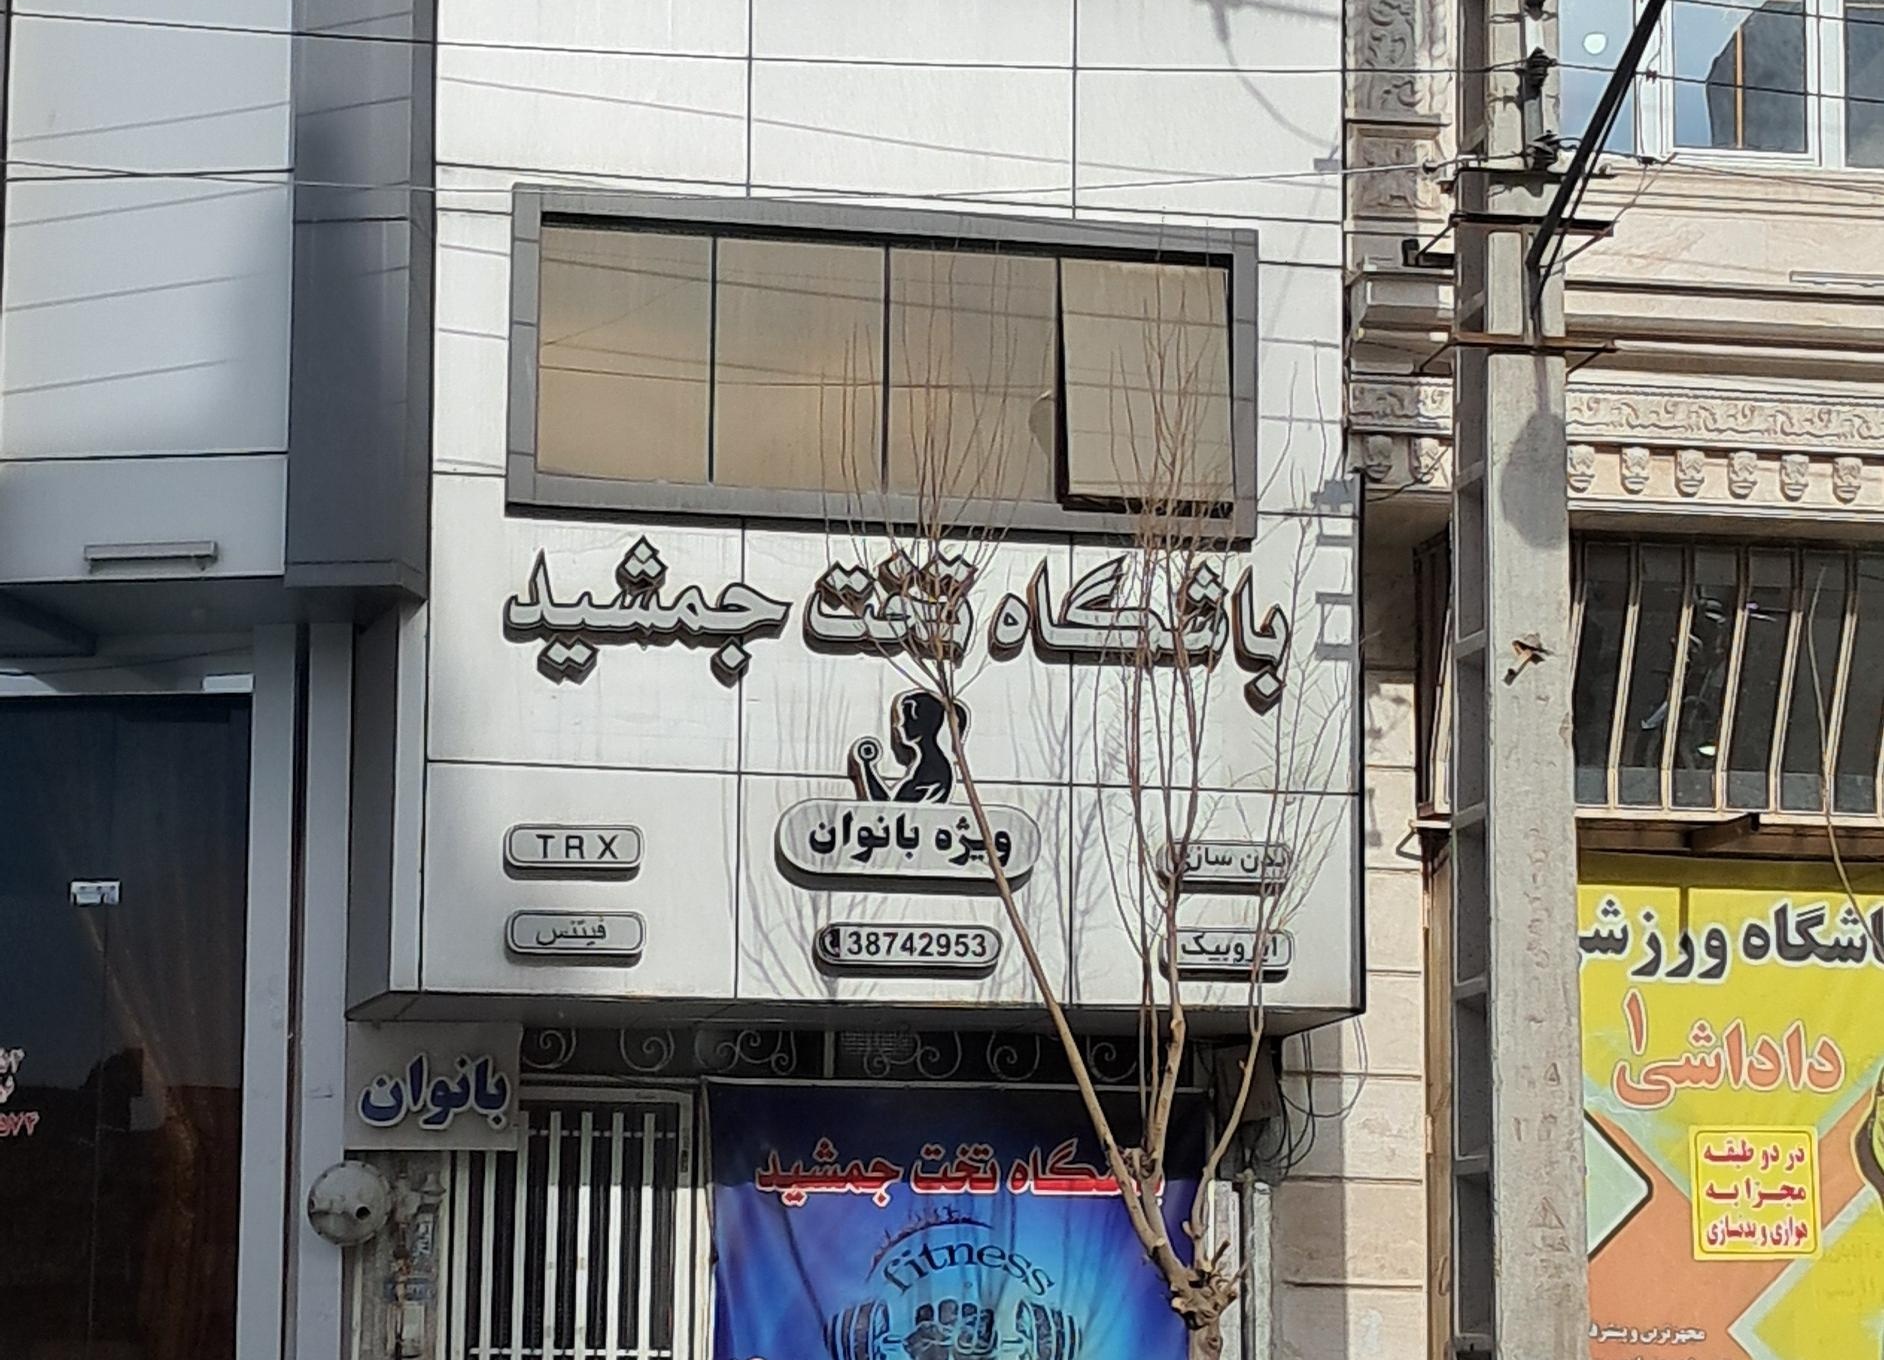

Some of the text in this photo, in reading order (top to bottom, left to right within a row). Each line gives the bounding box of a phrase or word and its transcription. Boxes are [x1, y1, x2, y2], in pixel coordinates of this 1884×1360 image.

[503, 534, 1291, 715] باشگاه تخت جمشید
[808, 809, 1012, 868] ویژه بانوان
[535, 916, 607, 946] فیتنس
[846, 930, 988, 958] 38742953
[1578, 898, 1884, 980] اشگاه ورزش
[360, 1052, 510, 1129] بانوان
[1614, 1018, 1843, 1109] داداشی
[755, 1136, 903, 1208] جمشید
[910, 1143, 999, 1194] تخت
[1703, 1139, 1805, 1171] در دو طبقه
[1705, 1177, 1807, 1208] مجزا به
[1760, 1225, 1768, 1247] و
[883, 1242, 1056, 1297] fitness
